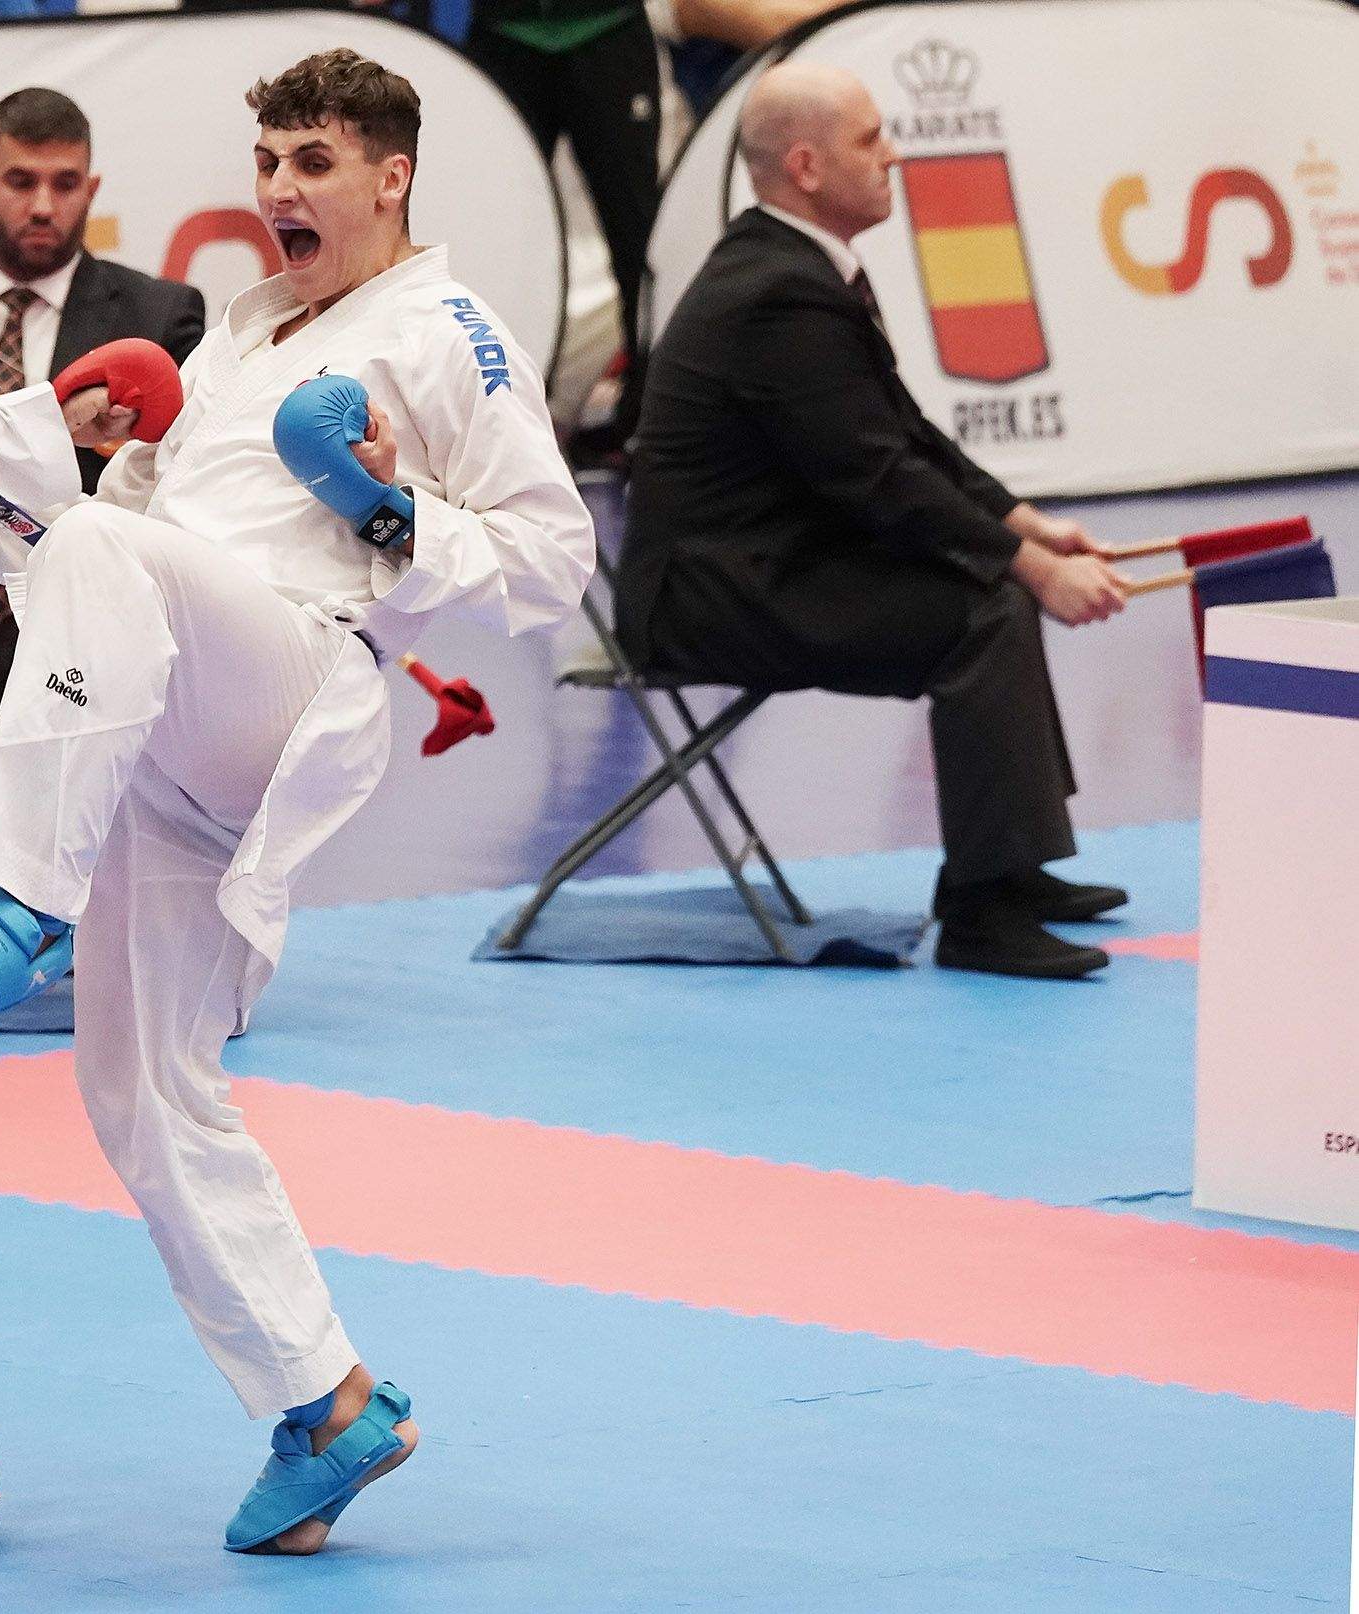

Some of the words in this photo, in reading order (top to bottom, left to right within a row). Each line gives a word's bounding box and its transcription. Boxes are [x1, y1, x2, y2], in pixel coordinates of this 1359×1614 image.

[441, 297, 512, 396] PUNOK
[372, 517, 400, 542] Daedo
[45, 672, 88, 707] Daedo
[1324, 1131, 1359, 1154] ESP
